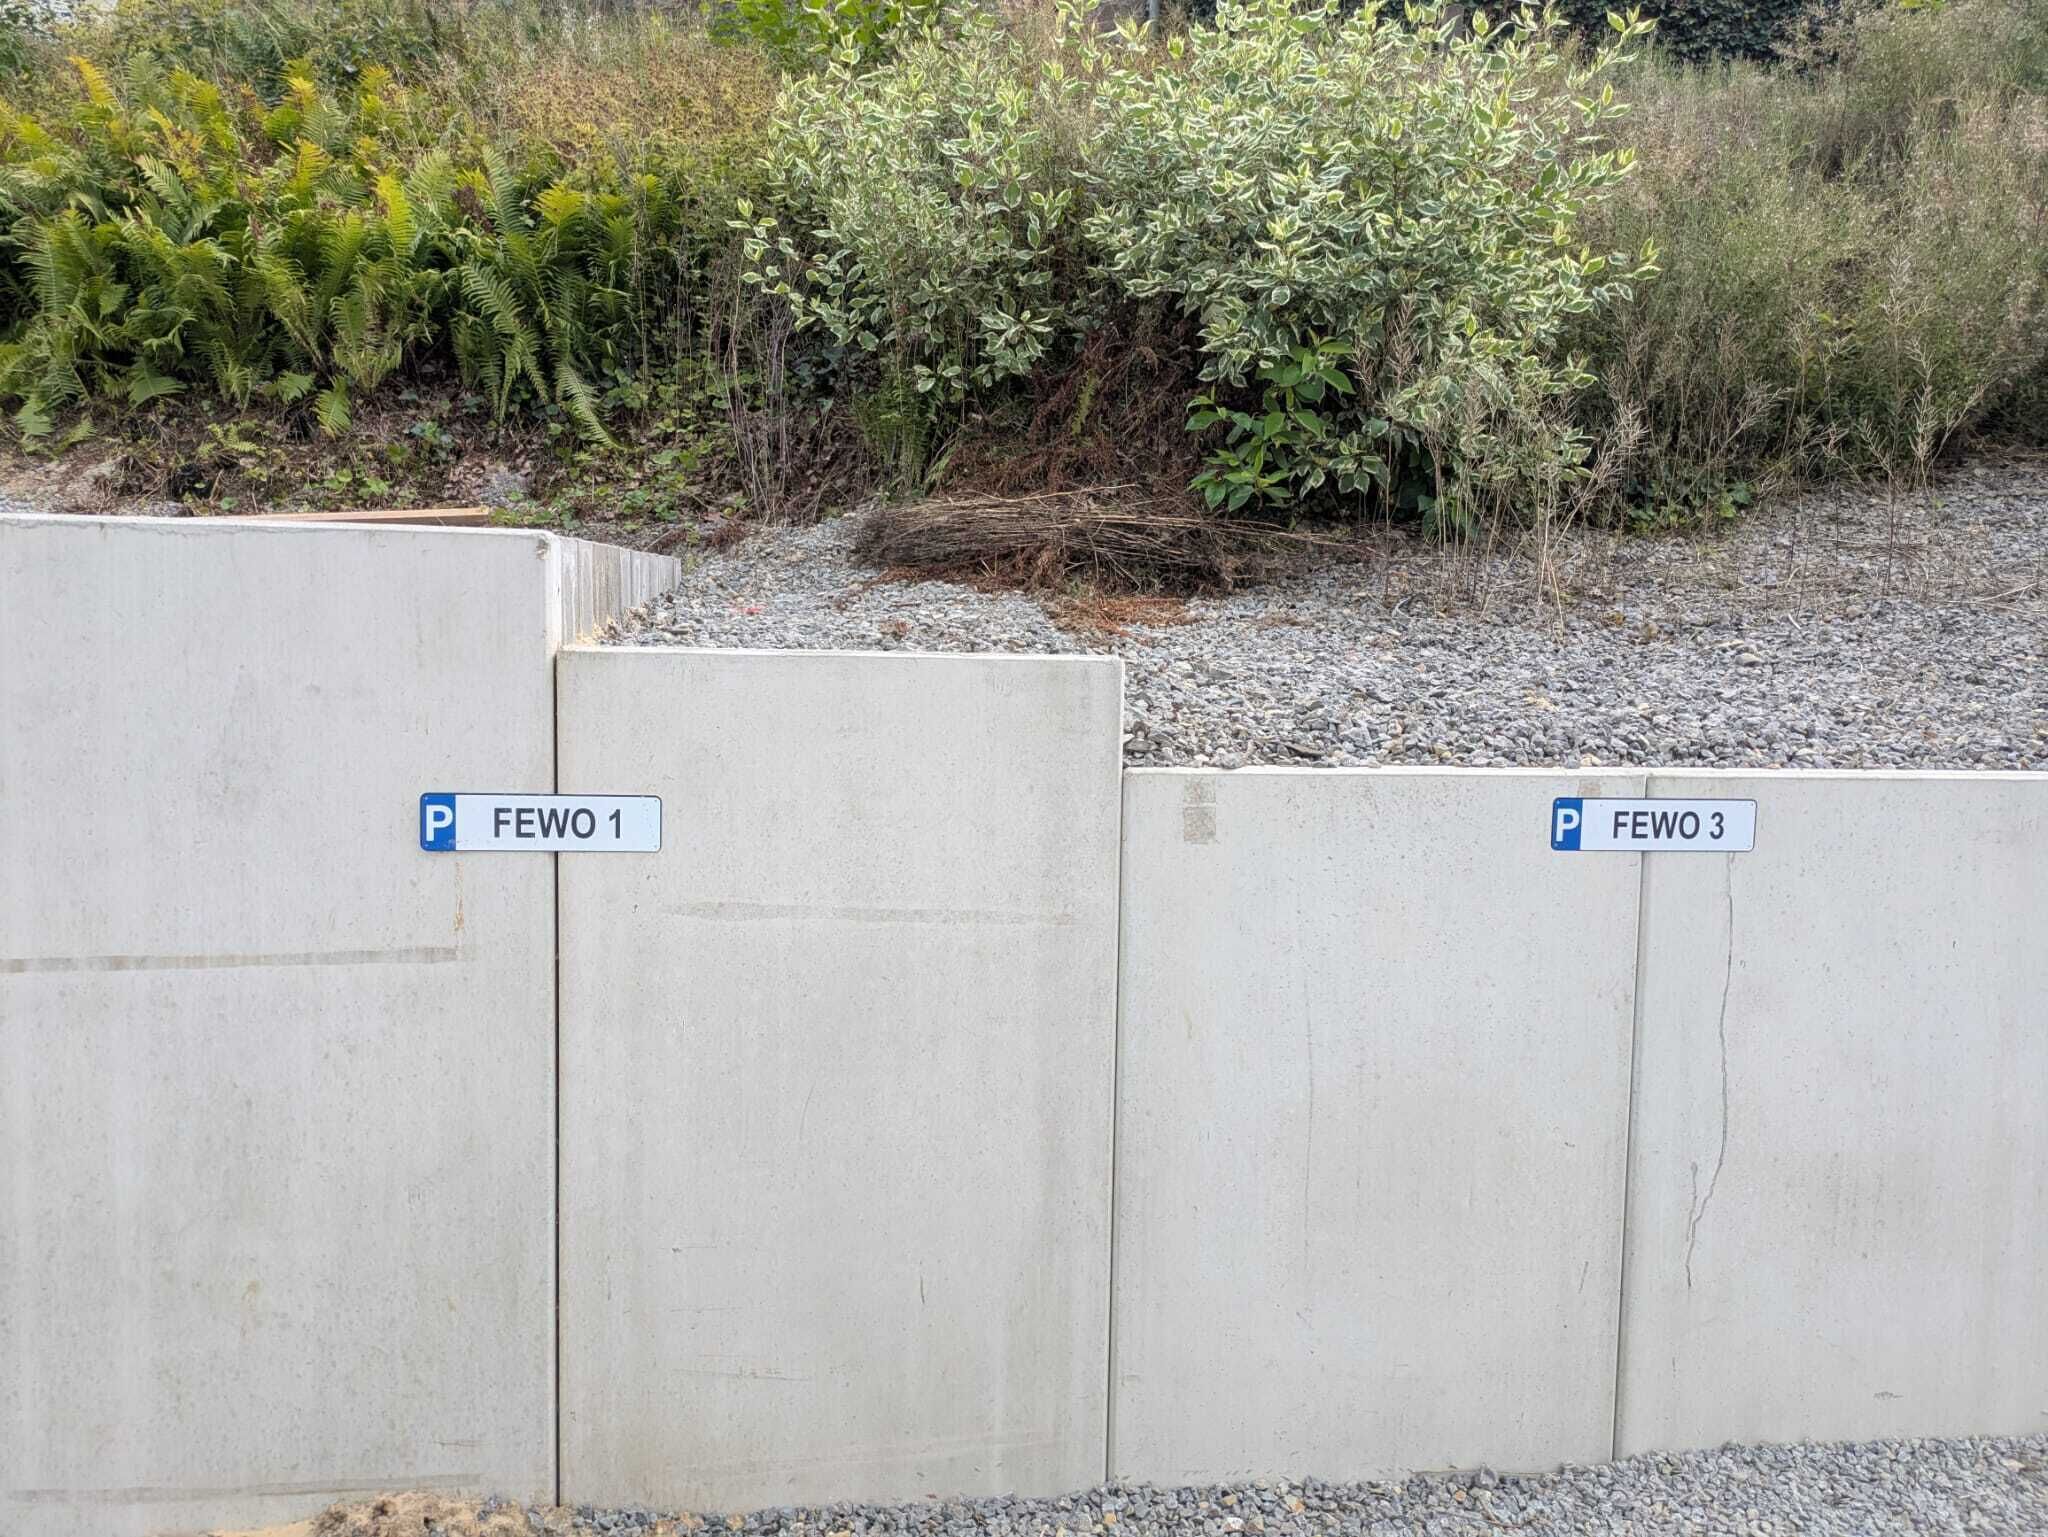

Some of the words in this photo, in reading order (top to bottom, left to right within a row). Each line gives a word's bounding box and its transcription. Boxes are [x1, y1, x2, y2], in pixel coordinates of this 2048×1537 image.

[426, 805, 453, 841] P
[494, 808, 596, 839] FEWO
[608, 808, 621, 839] 1
[1556, 808, 1580, 842] P
[1613, 811, 1700, 839] FEWO
[1709, 811, 1724, 839] 3
